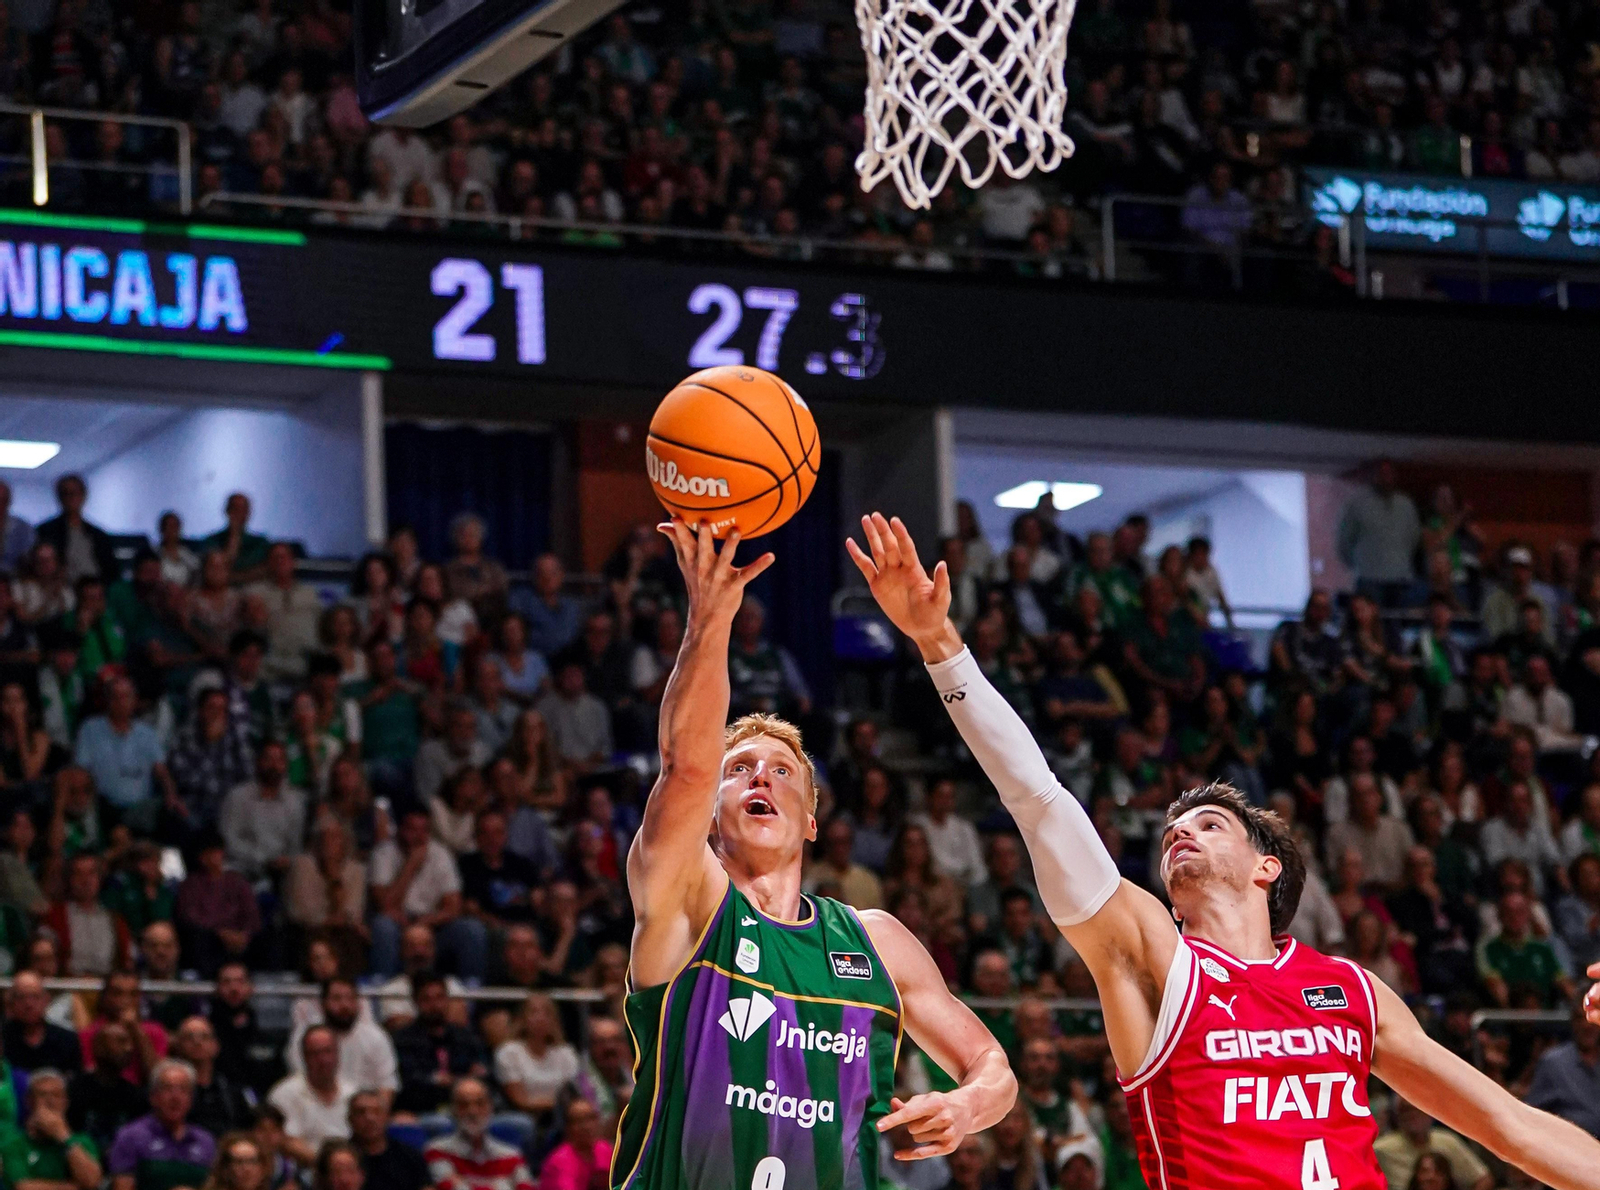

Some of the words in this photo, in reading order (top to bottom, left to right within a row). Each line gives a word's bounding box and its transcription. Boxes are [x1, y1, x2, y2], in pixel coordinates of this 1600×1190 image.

[430, 257, 546, 365] 21
[646, 446, 730, 497] Wilson
[835, 958, 852, 968] liga
[837, 966, 870, 976] endesa
[1307, 994, 1325, 1002] liga
[1310, 998, 1345, 1007] endesa
[1205, 1024, 1362, 1062] GIRONA
[1223, 1072, 1372, 1124] FIATC
